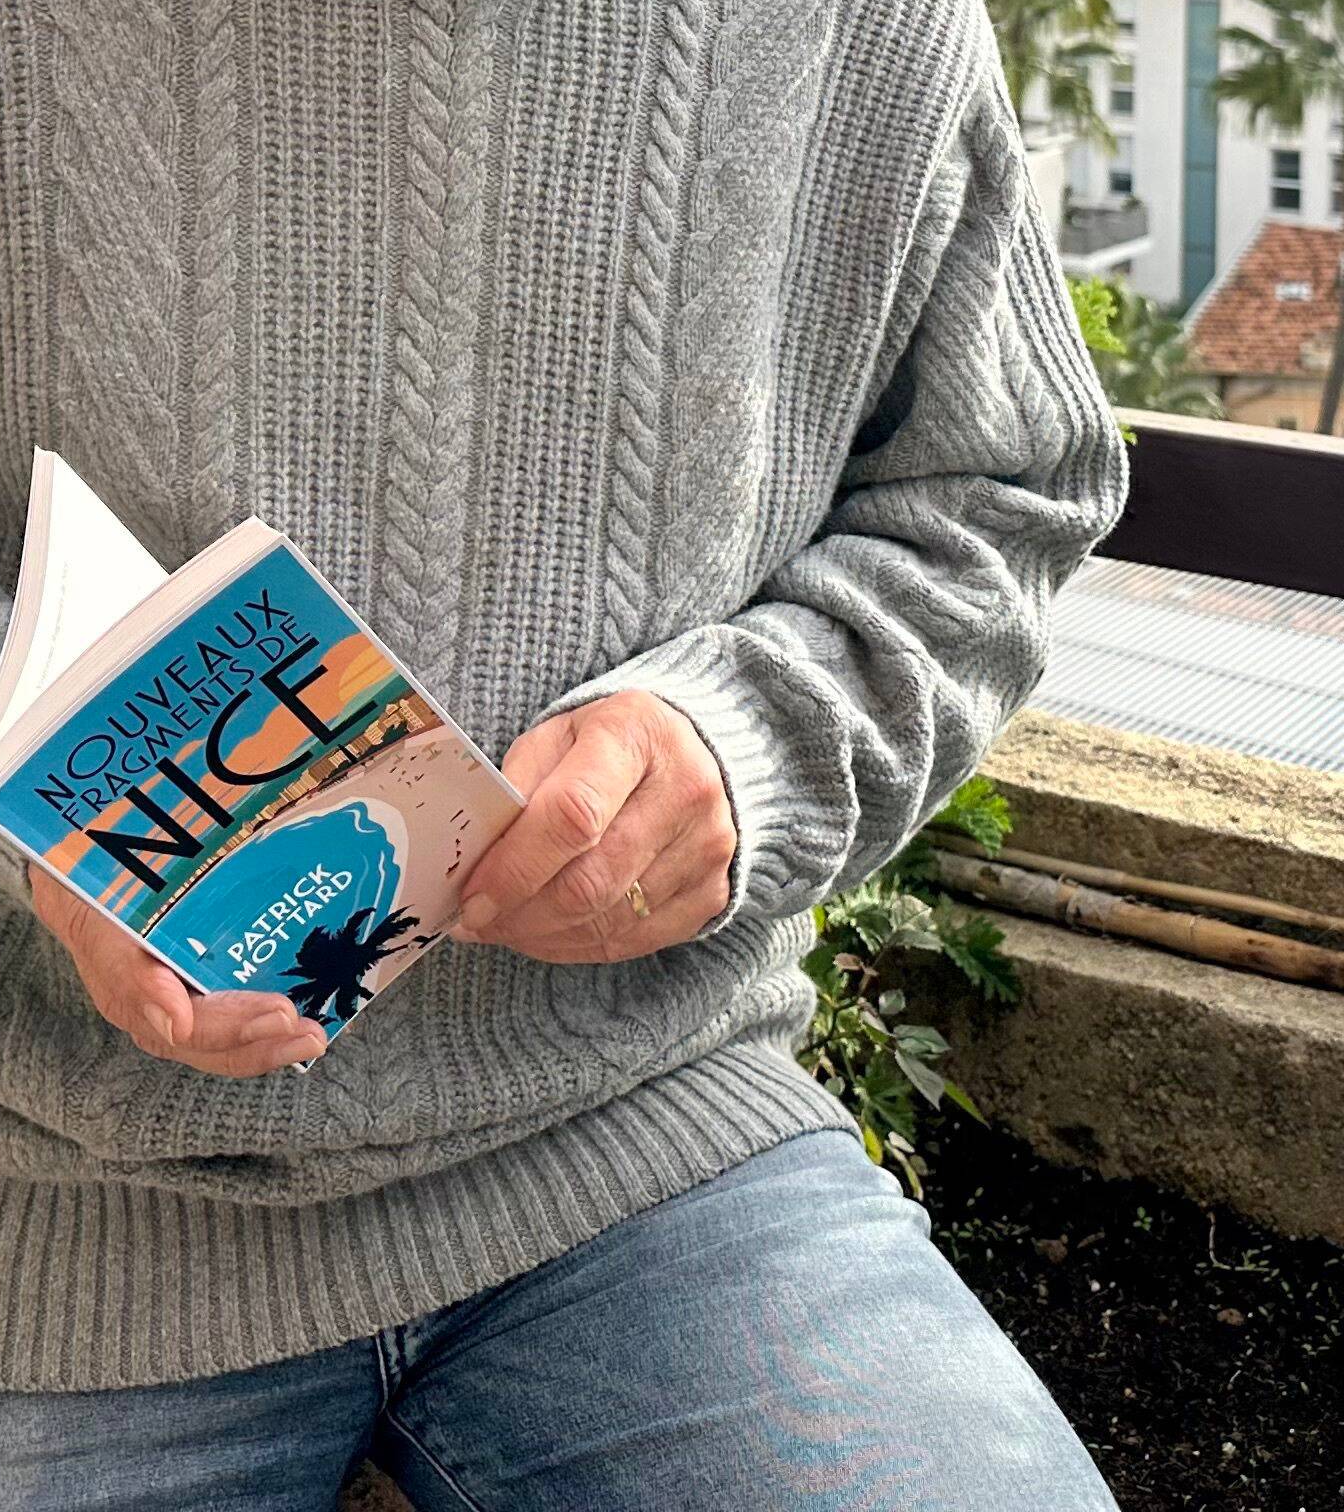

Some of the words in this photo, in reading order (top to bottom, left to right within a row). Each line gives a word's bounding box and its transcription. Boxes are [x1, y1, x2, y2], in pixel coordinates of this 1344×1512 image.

[34, 589, 289, 811] NOUVEAUX
[61, 660, 254, 831] FRAGMENTS
[256, 615, 311, 663] DE
[84, 637, 378, 893] NICE
[227, 863, 332, 962] PATRICK
[232, 871, 353, 983] MOTTARD
